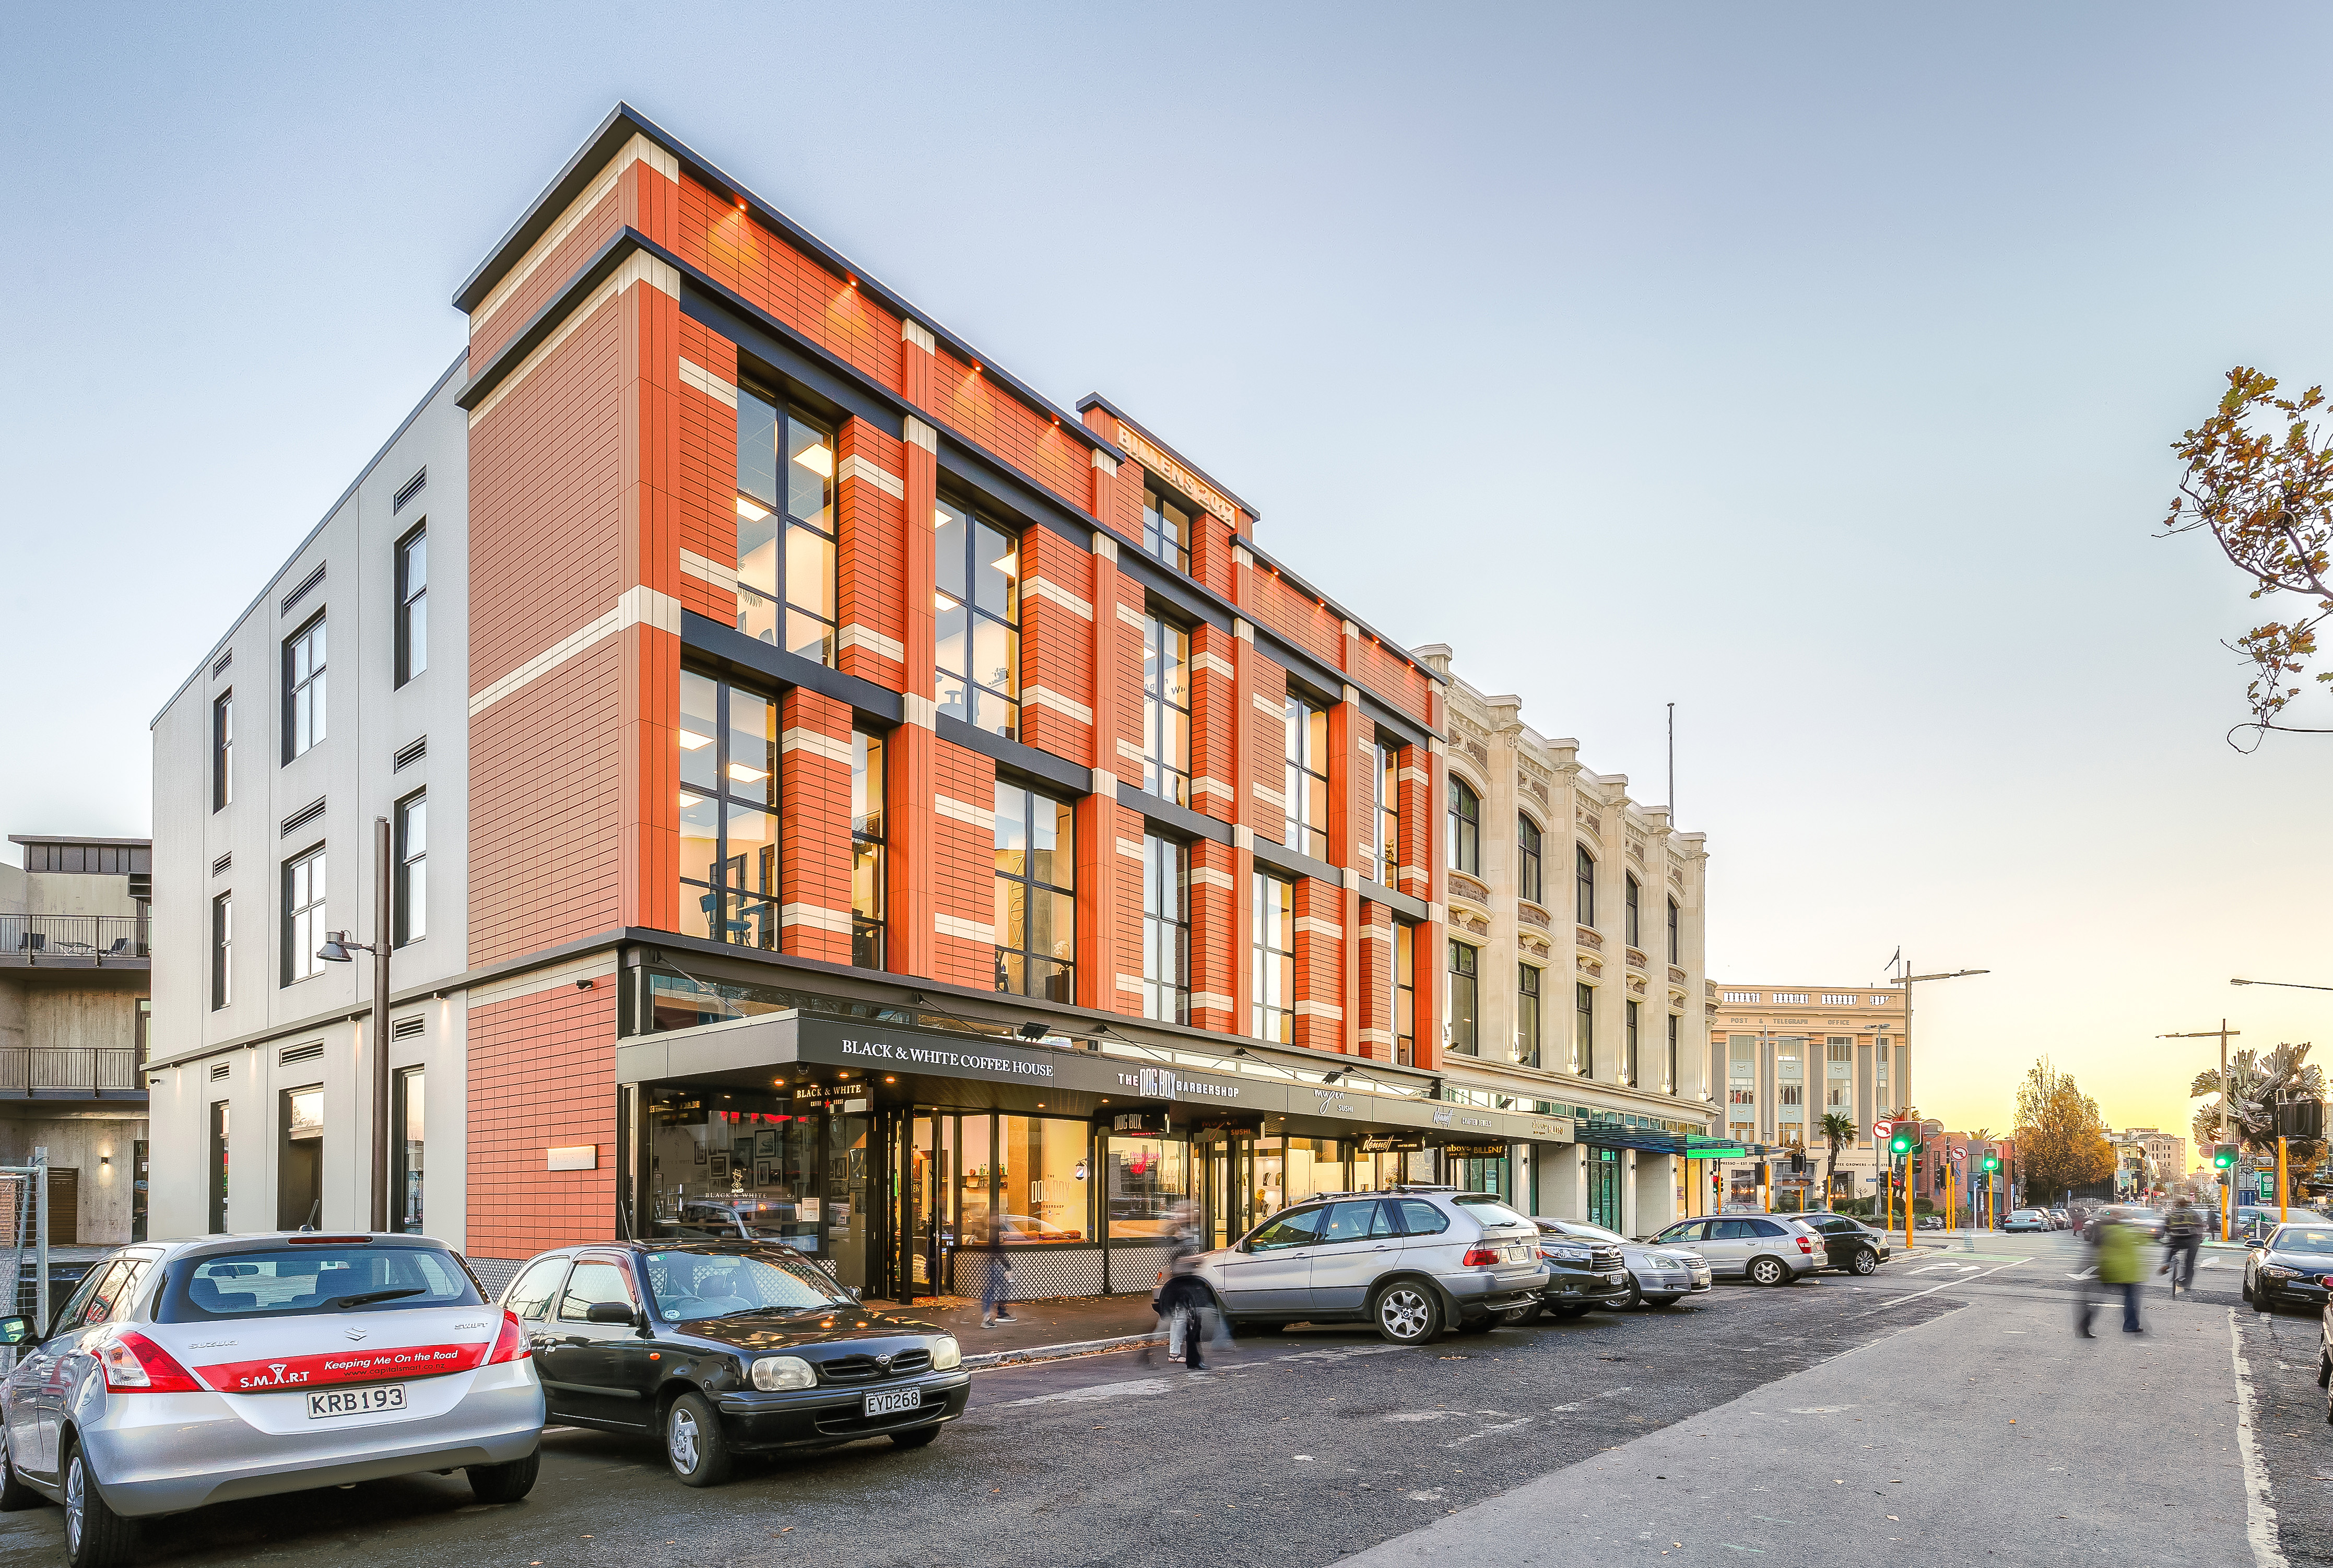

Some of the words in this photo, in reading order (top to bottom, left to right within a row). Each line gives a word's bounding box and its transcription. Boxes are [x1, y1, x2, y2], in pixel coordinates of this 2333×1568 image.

[1198, 485, 1234, 522] 2017
[842, 1040, 893, 1058] BLACK
[895, 1046, 909, 1060] &
[909, 1048, 959, 1066] WHITE
[960, 1055, 1010, 1072] COFFEE
[1012, 1060, 1054, 1077] HOUSE
[796, 1088, 822, 1098] BLACK
[833, 1084, 861, 1094] WHITE
[1117, 1073, 1139, 1087] THE
[1139, 1068, 1158, 1097] DOG
[1159, 1069, 1176, 1100] BOX
[1176, 1080, 1240, 1098] BARBERSHOP
[1337, 1104, 1354, 1113] SUSHI
[1114, 1114, 1127, 1131] DOG
[1129, 1114, 1142, 1129] BOX
[1031, 1180, 1050, 1204] DOG
[454, 1322, 488, 1330] SWIFT
[188, 1339, 240, 1349] SUZUKI
[324, 1359, 371, 1370] Keeping
[374, 1357, 391, 1365] Me
[394, 1354, 411, 1363] On
[414, 1352, 431, 1362] the
[433, 1350, 458, 1360] Road
[344, 1363, 445, 1376] www.capitalsmart.co.nz
[312, 1388, 403, 1414] KRB193
[868, 1392, 919, 1413] EYD268
